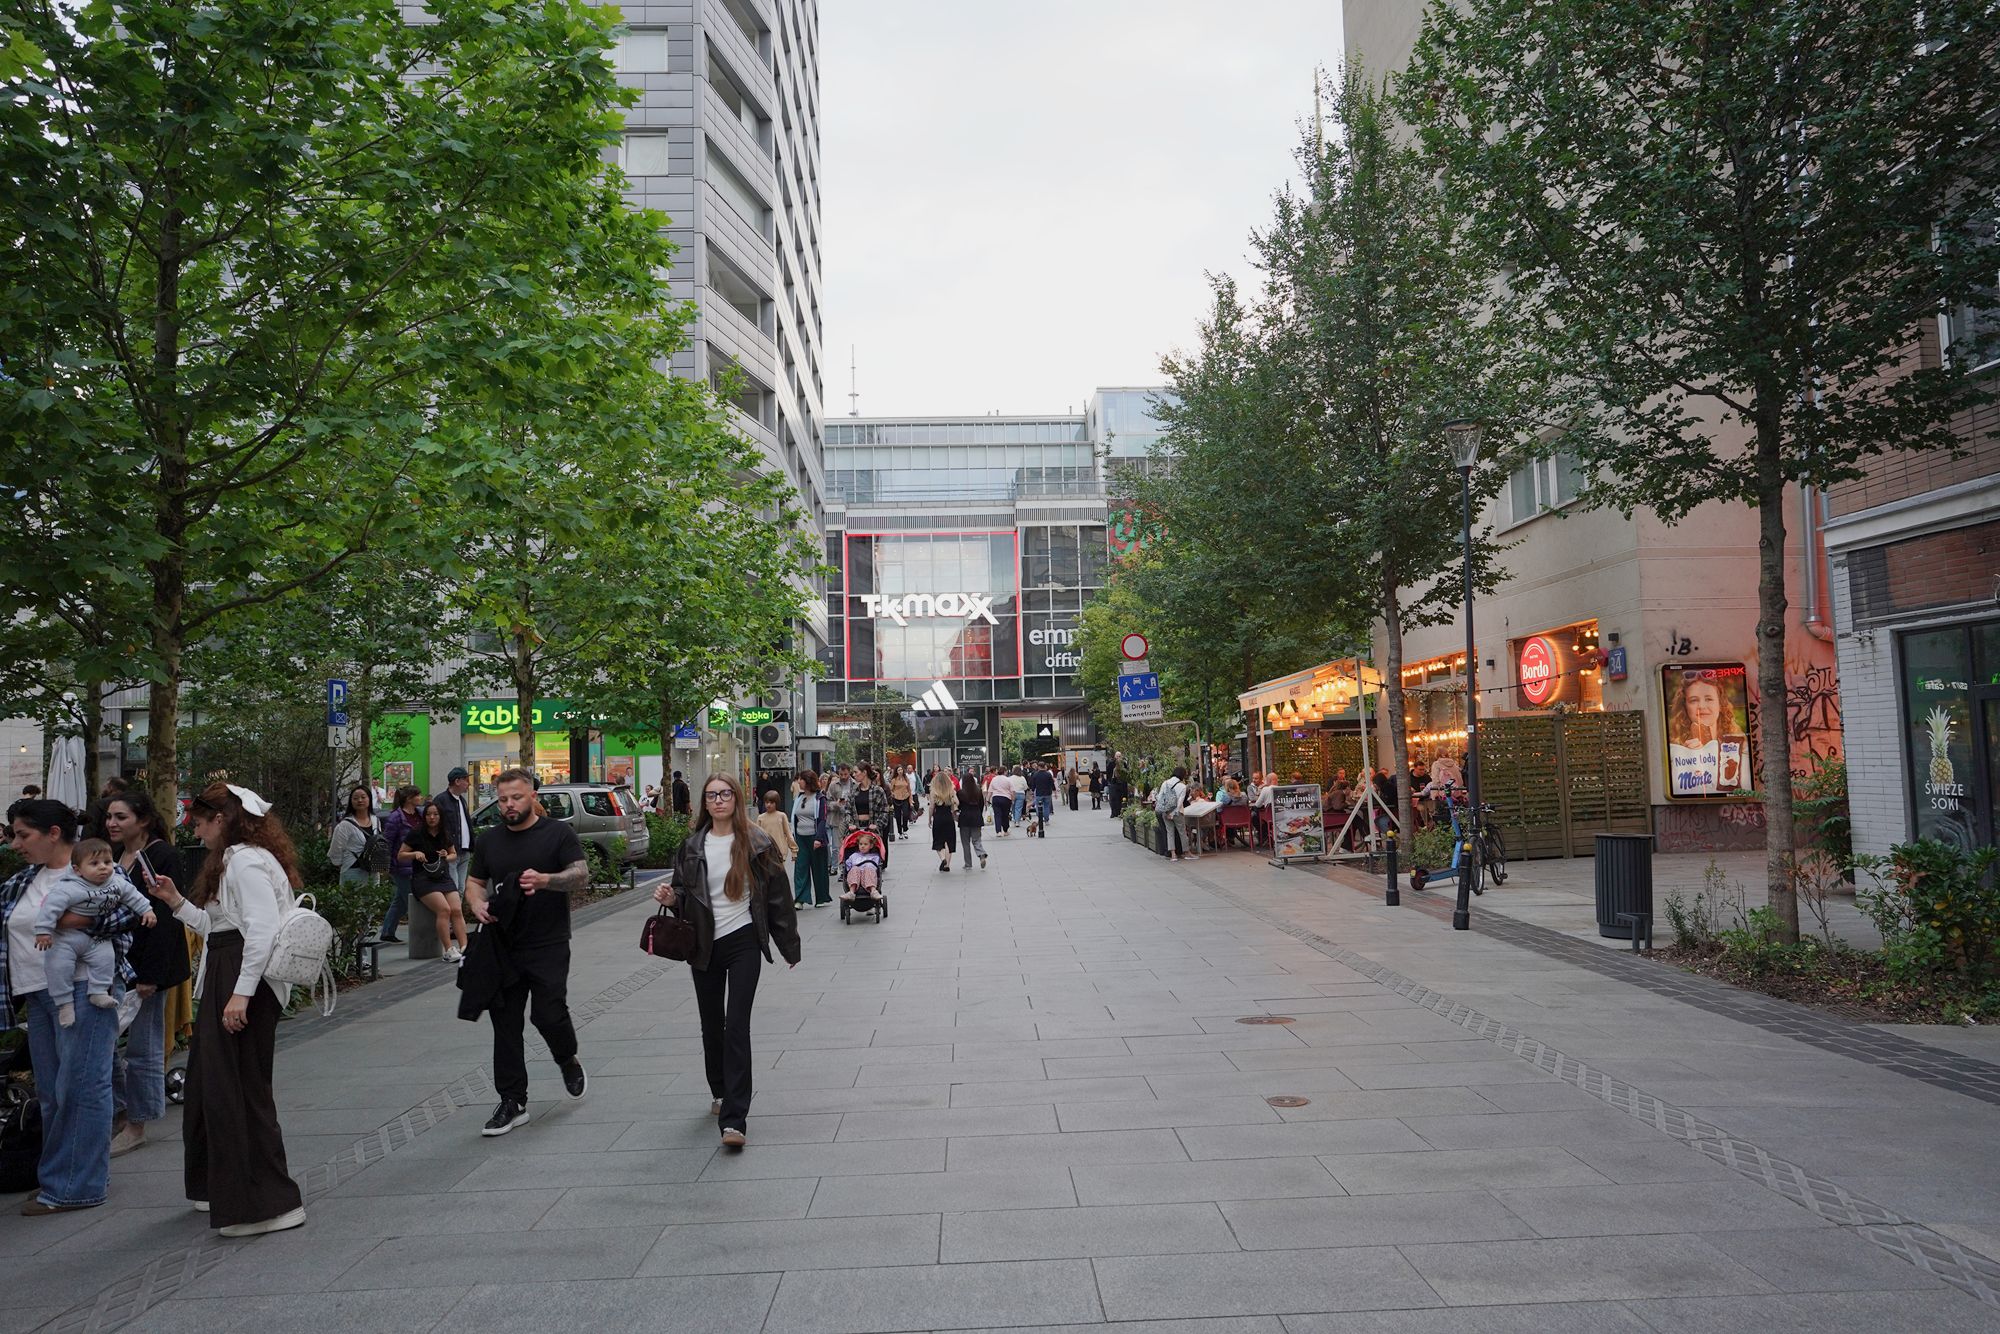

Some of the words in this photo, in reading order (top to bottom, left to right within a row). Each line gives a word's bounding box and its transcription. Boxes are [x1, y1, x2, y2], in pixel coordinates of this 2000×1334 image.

[1522, 660, 1549, 680] Bordo
[1610, 656, 1622, 674] 34
[1675, 757, 1697, 767] Nowe
[1700, 753, 1716, 766] lody
[1678, 770, 1712, 790] Monte
[1925, 780, 1964, 796] ŚWIEŻE
[1276, 793, 1315, 804] śniadanie
[1931, 797, 1959, 811] SOKI
